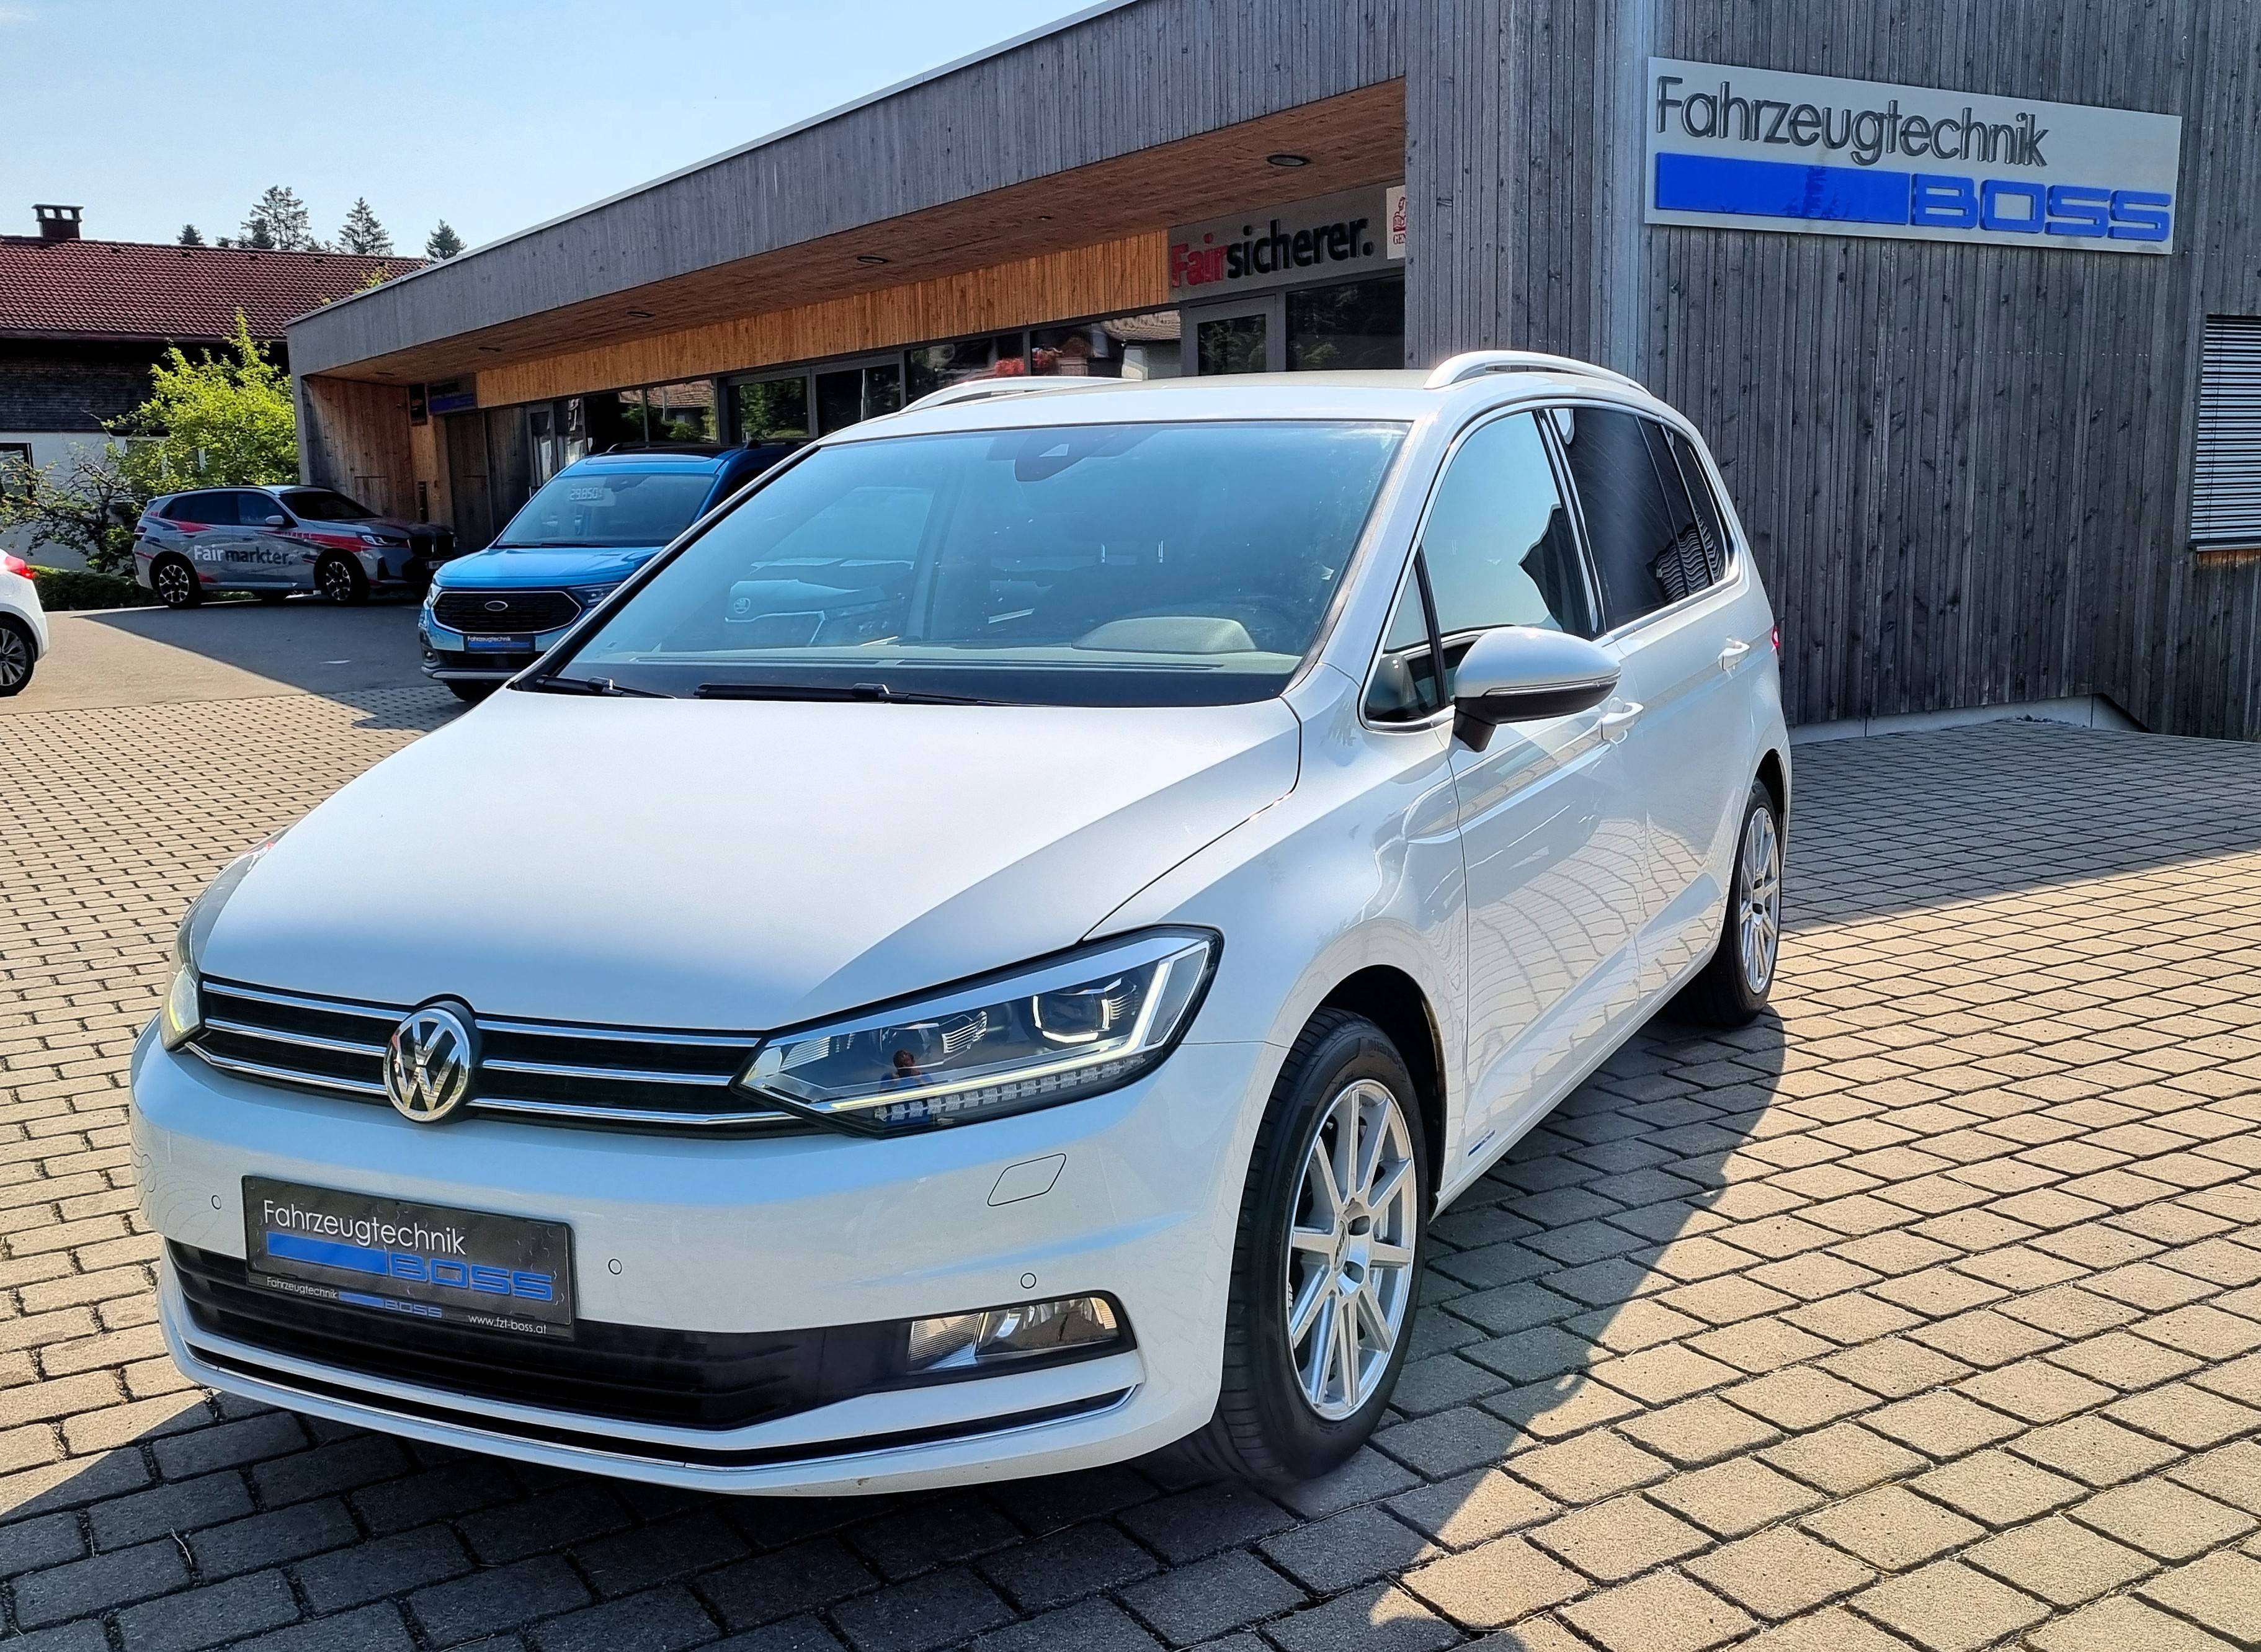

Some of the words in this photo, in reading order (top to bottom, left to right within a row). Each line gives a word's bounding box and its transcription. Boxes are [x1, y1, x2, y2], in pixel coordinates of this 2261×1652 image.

[1656, 75, 2048, 167] Fahrzeugtechnik
[1911, 172, 2172, 241] BOSS
[384, 1008, 470, 1122] VW
[263, 1200, 466, 1256] Fahrzeugtechnik
[266, 1277, 338, 1299] Fahrzeugtechnik
[384, 1299, 442, 1319] BOSS
[467, 1314, 547, 1335] www.fzt-boss.at
[388, 1251, 553, 1302] BOSS
